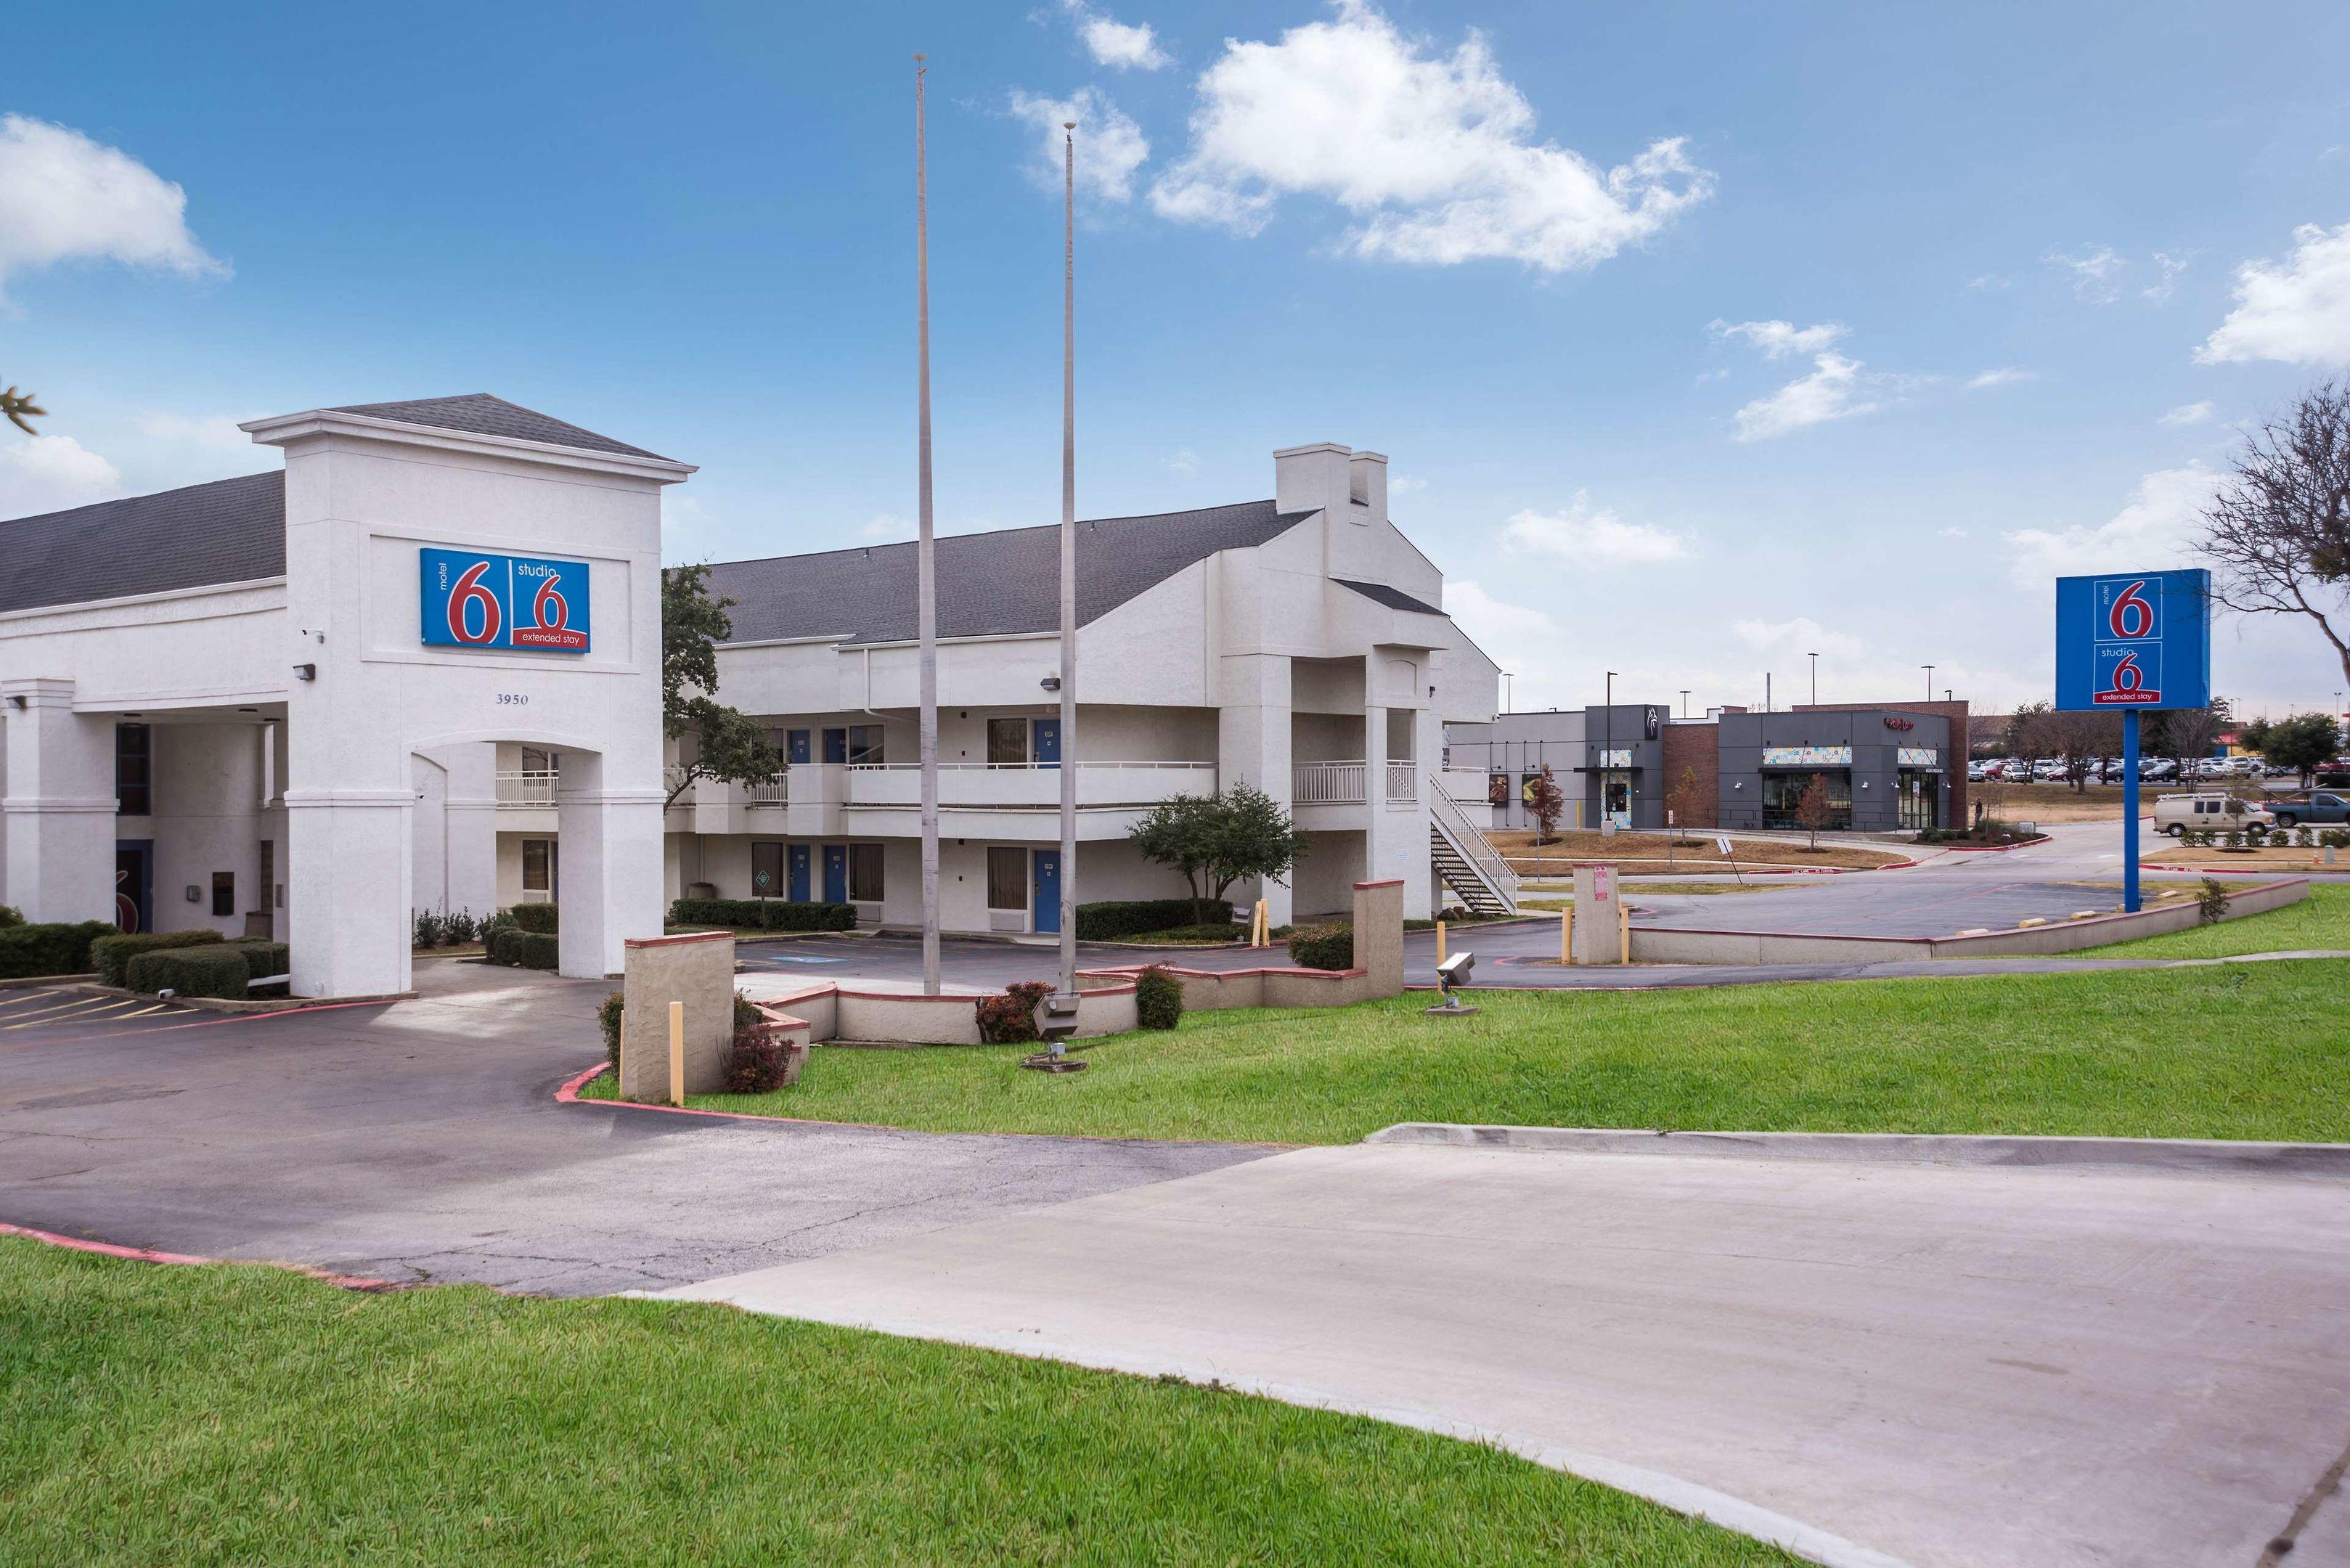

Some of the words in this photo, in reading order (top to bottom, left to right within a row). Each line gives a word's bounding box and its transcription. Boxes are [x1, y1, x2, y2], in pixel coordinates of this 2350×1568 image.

[438, 563, 447, 590] motel
[518, 563, 557, 579] studio
[447, 561, 502, 644] 6
[534, 574, 568, 631] 6
[2109, 581, 2153, 638] 6
[523, 634, 561, 643] extended
[563, 636, 580, 645] stay
[2101, 648, 2134, 657] studio
[2112, 653, 2143, 691] 6
[496, 693, 529, 705] 3950
